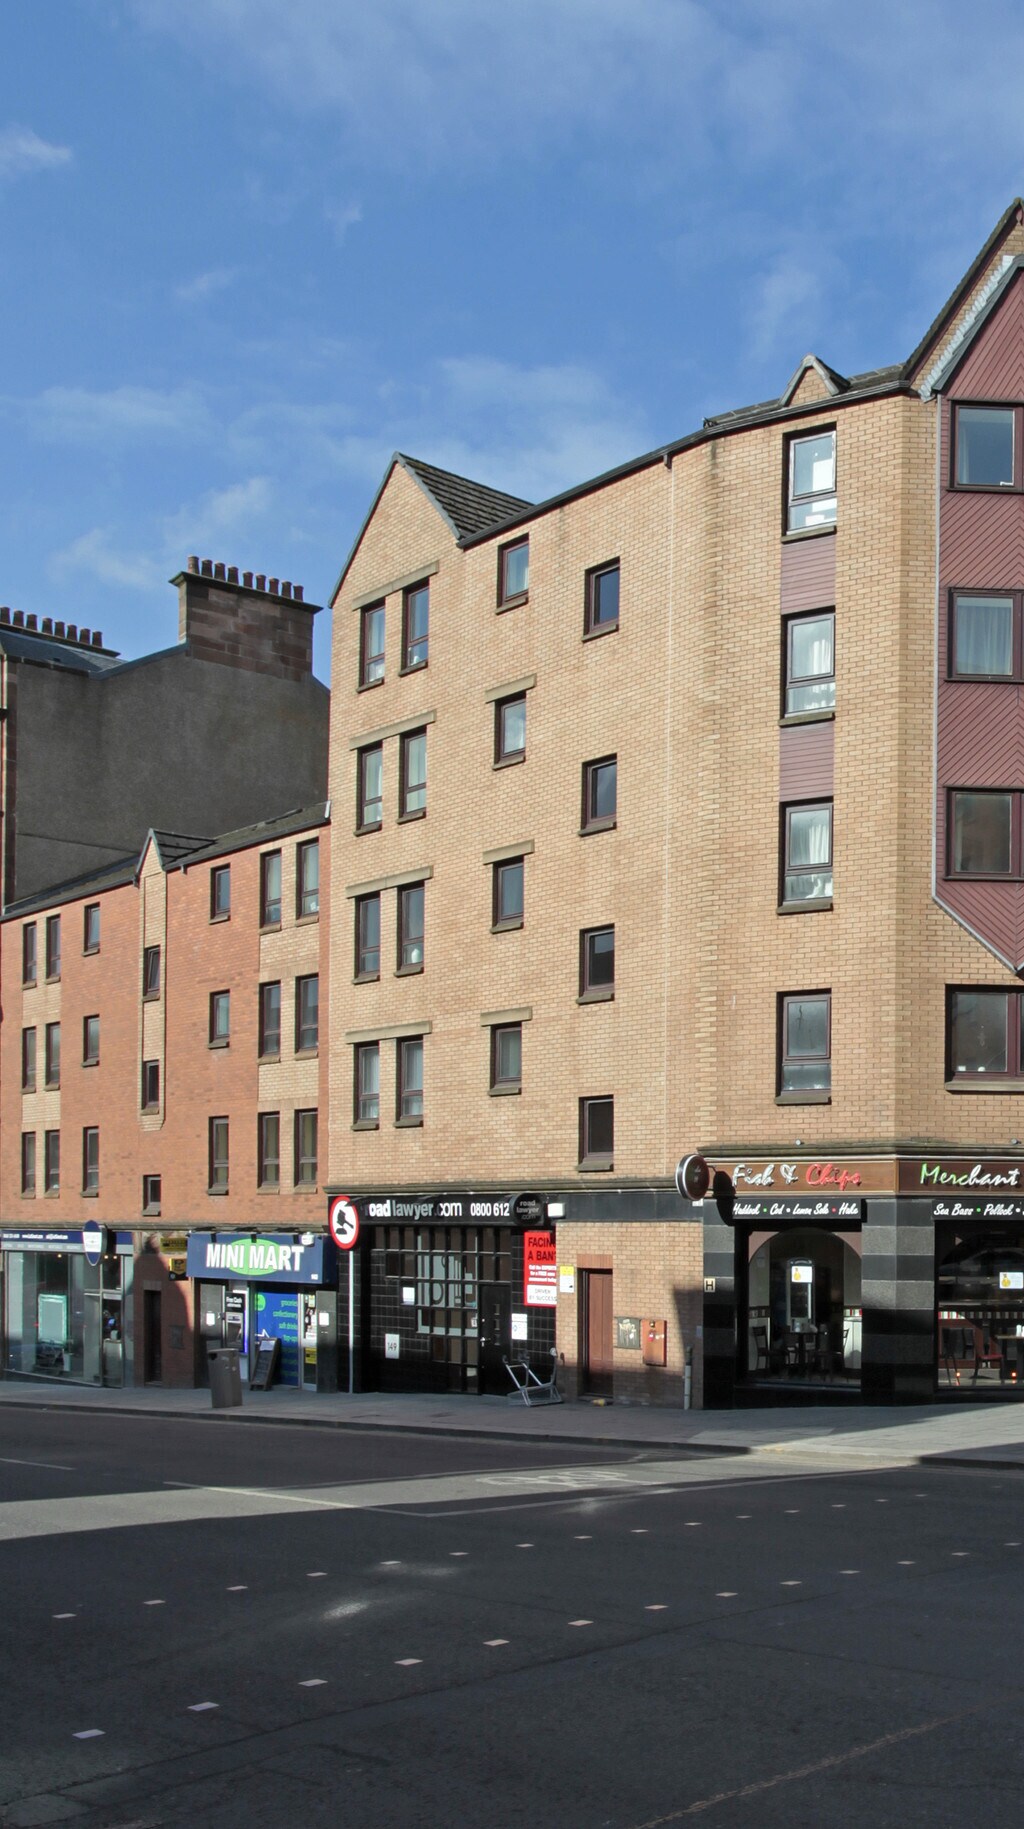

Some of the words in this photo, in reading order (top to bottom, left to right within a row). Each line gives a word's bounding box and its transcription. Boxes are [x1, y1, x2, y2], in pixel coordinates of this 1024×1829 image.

[732, 1164, 775, 1187] Fish
[780, 1164, 798, 1185] &
[806, 1163, 861, 1191] Chips
[920, 1163, 1020, 1186] Merchant
[470, 1202, 492, 1217] 0800
[493, 1202, 510, 1217] 612
[516, 1206, 539, 1214] lawyer
[770, 1203, 783, 1215] Cod
[792, 1203, 812, 1215] Lemon
[813, 1203, 829, 1215] Sole
[838, 1203, 859, 1215] Hake
[933, 1203, 949, 1216] Sea
[951, 1203, 973, 1216] Bass
[983, 1203, 1014, 1216] Pollock
[206, 1243, 245, 1268] MINI
[248, 1244, 304, 1271] MART
[527, 1250, 534, 1261] A
[387, 1342, 397, 1352] 149
